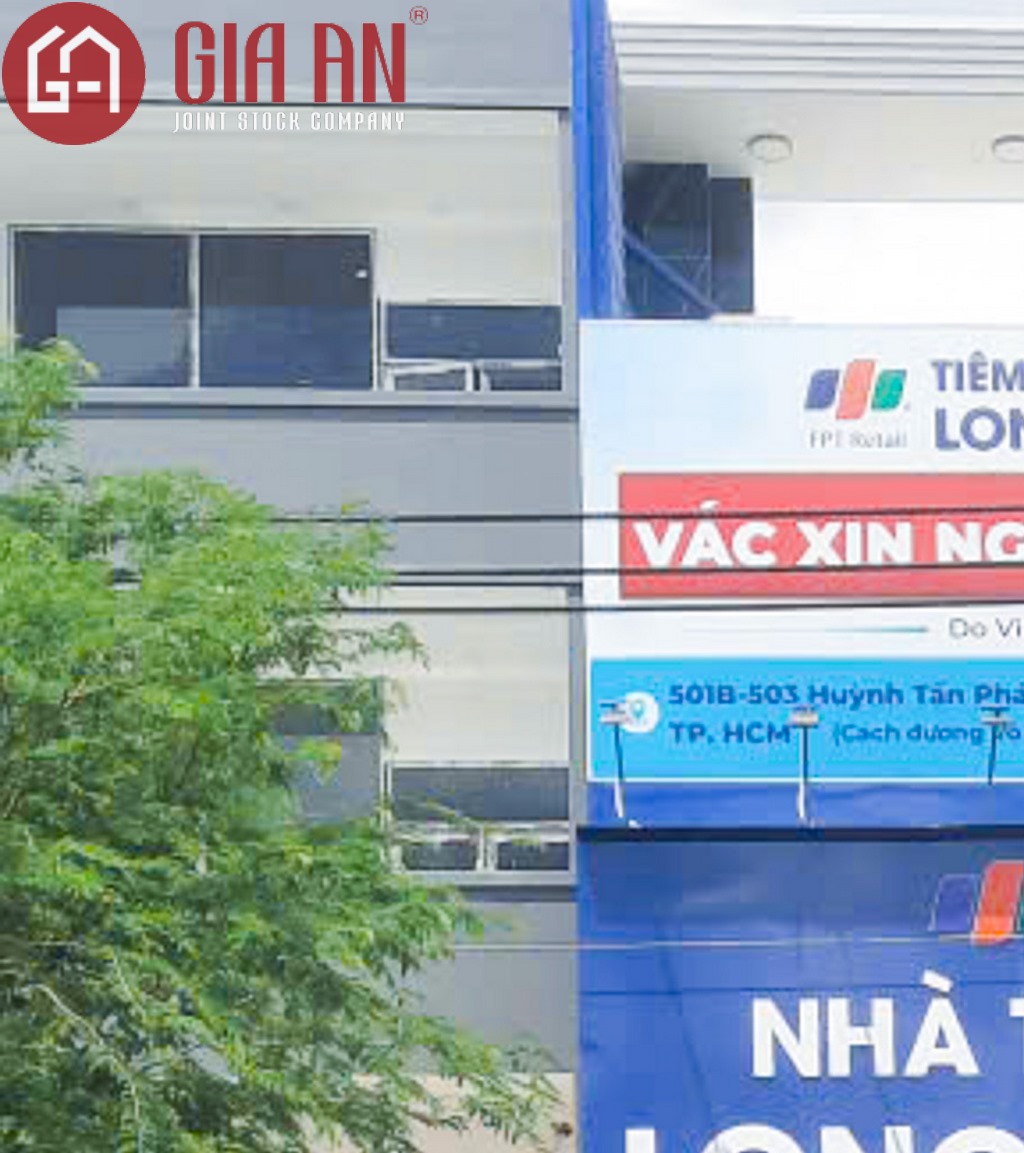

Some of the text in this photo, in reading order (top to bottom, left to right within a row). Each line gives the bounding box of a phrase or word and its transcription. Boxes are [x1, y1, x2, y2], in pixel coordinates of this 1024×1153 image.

[632, 499, 777, 567] VÁC
[796, 520, 913, 566] XIN
[949, 617, 988, 638] Do
[668, 722, 790, 743] TP. HCM
[751, 969, 981, 1077] NHÀ
